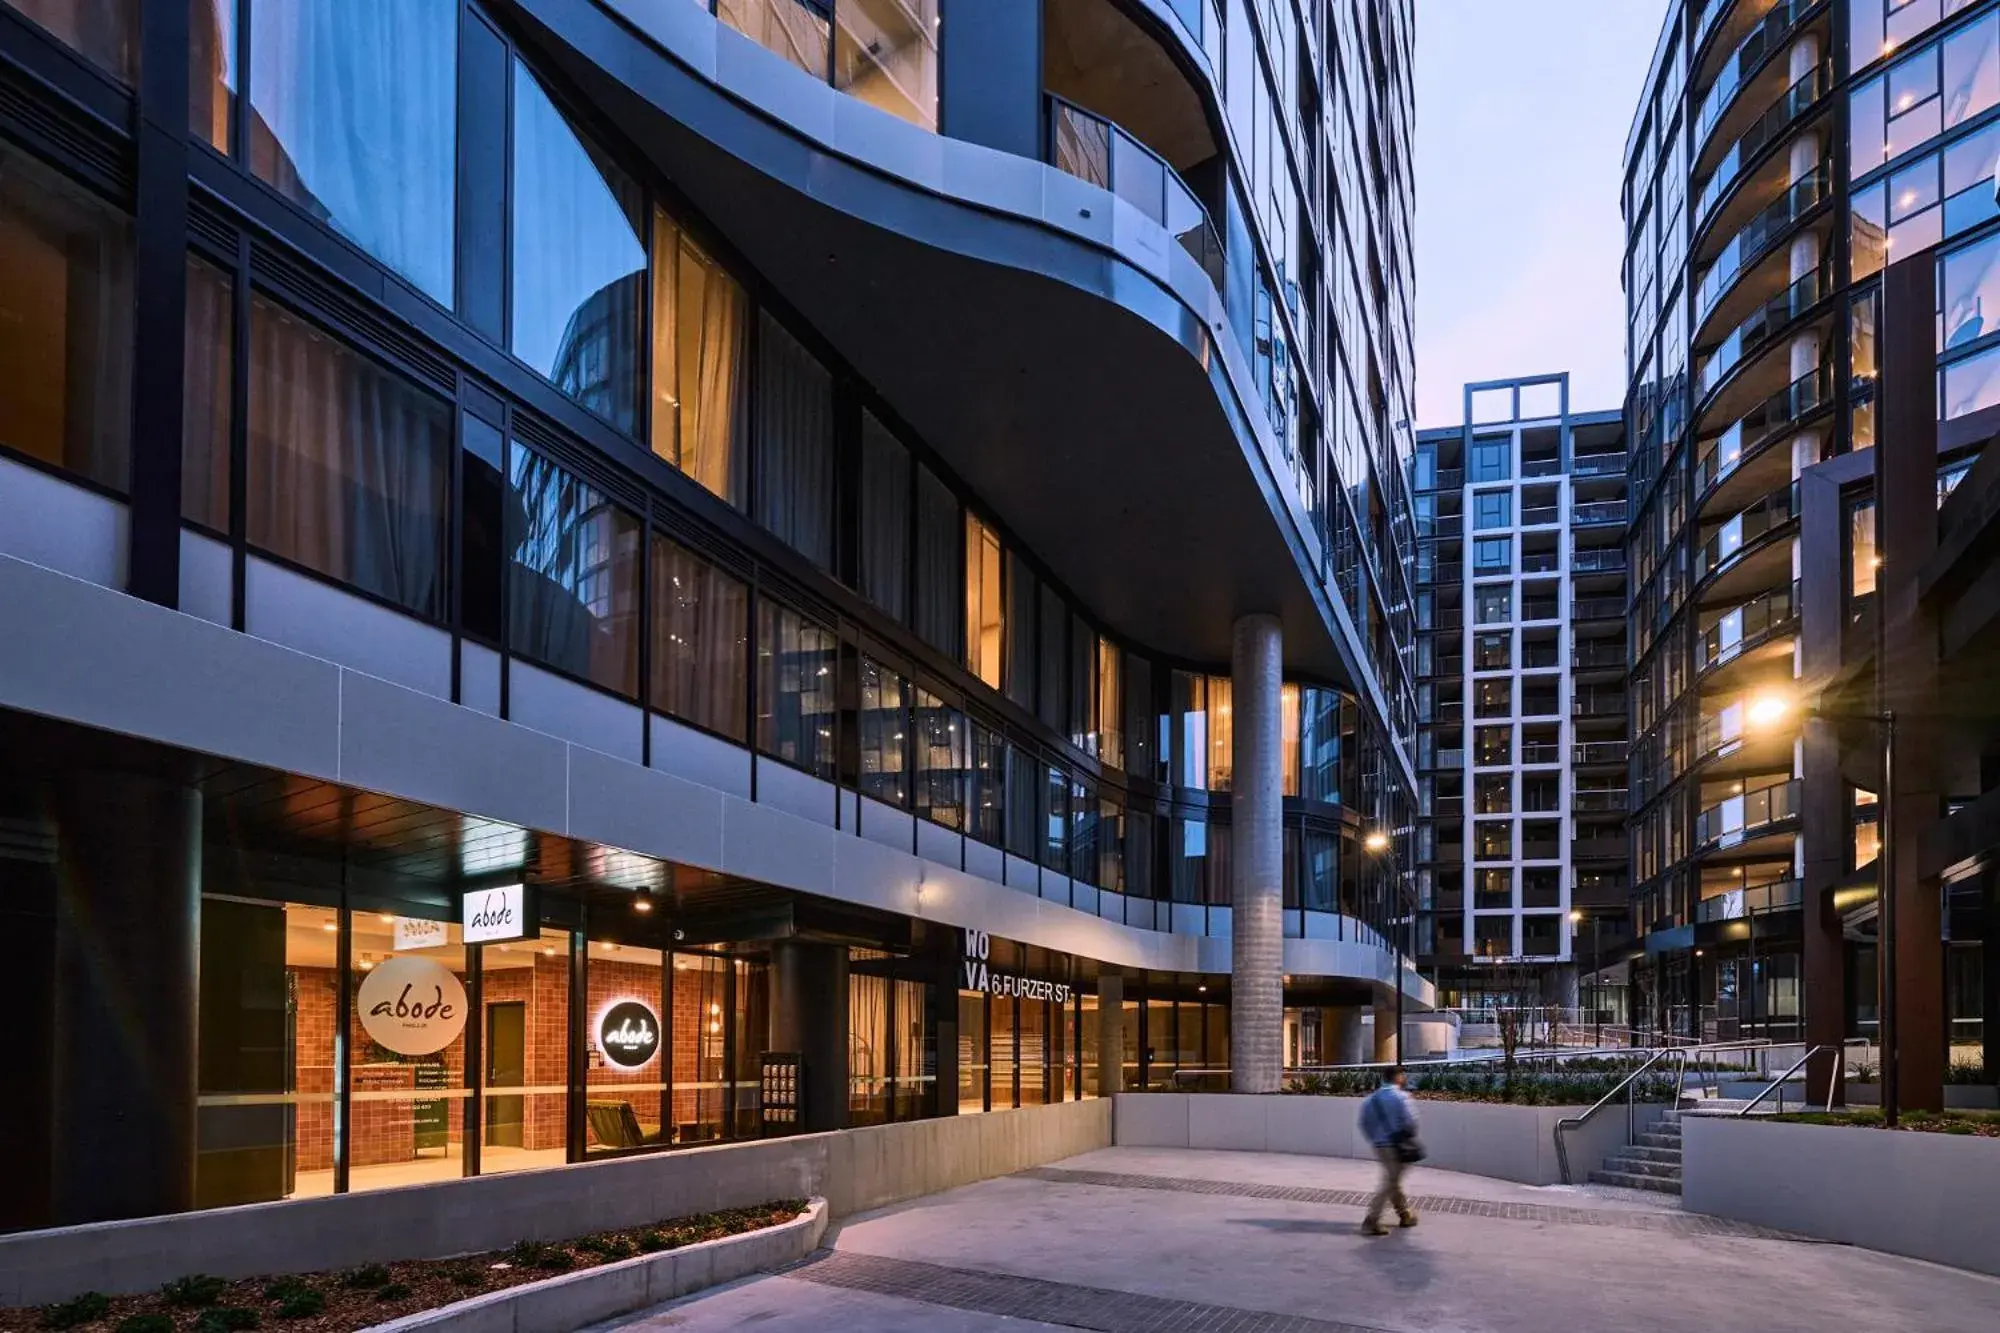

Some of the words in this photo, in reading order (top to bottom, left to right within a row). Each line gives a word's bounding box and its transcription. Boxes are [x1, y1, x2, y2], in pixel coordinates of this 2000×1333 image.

[472, 892, 513, 928] abode
[370, 983, 456, 1019] abode
[991, 974, 1001, 995] 6
[1003, 975, 1053, 1001] FURZER
[605, 1018, 654, 1044] abode
